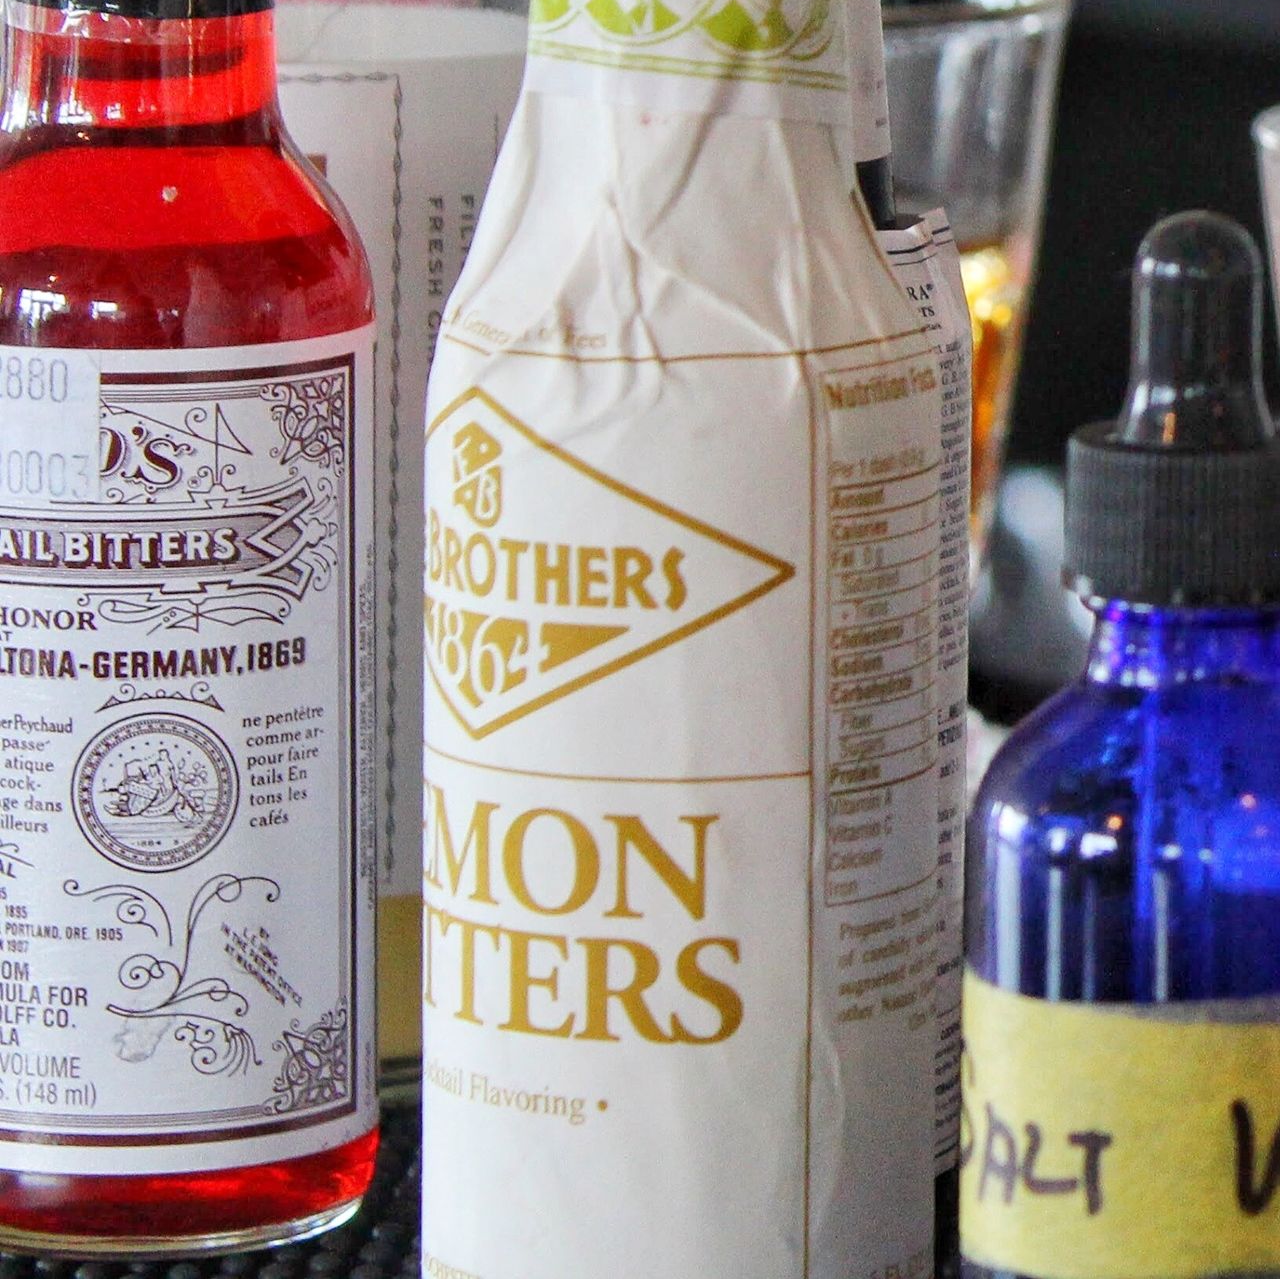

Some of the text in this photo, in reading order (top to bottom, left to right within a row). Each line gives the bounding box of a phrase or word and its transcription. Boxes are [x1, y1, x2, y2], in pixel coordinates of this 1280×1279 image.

[427, 196, 444, 296] FRESH
[62, 526, 241, 569] BITTERS
[429, 506, 687, 612] BROTHERS
[242, 716, 262, 728] ne
[245, 730, 302, 747] comme
[247, 753, 284, 770] pour
[250, 768, 284, 786] tails
[288, 786, 308, 801] les
[23, 795, 63, 813] dans
[423, 778, 721, 922] MON
[95, 927, 123, 941] 1905
[48, 986, 88, 1006] FOR
[43, 1008, 76, 1028] CO.
[0, 1051, 81, 1079] VOLUME
[65, 1081, 96, 1108] ml)
[469, 1071, 586, 1126] Flavoring
